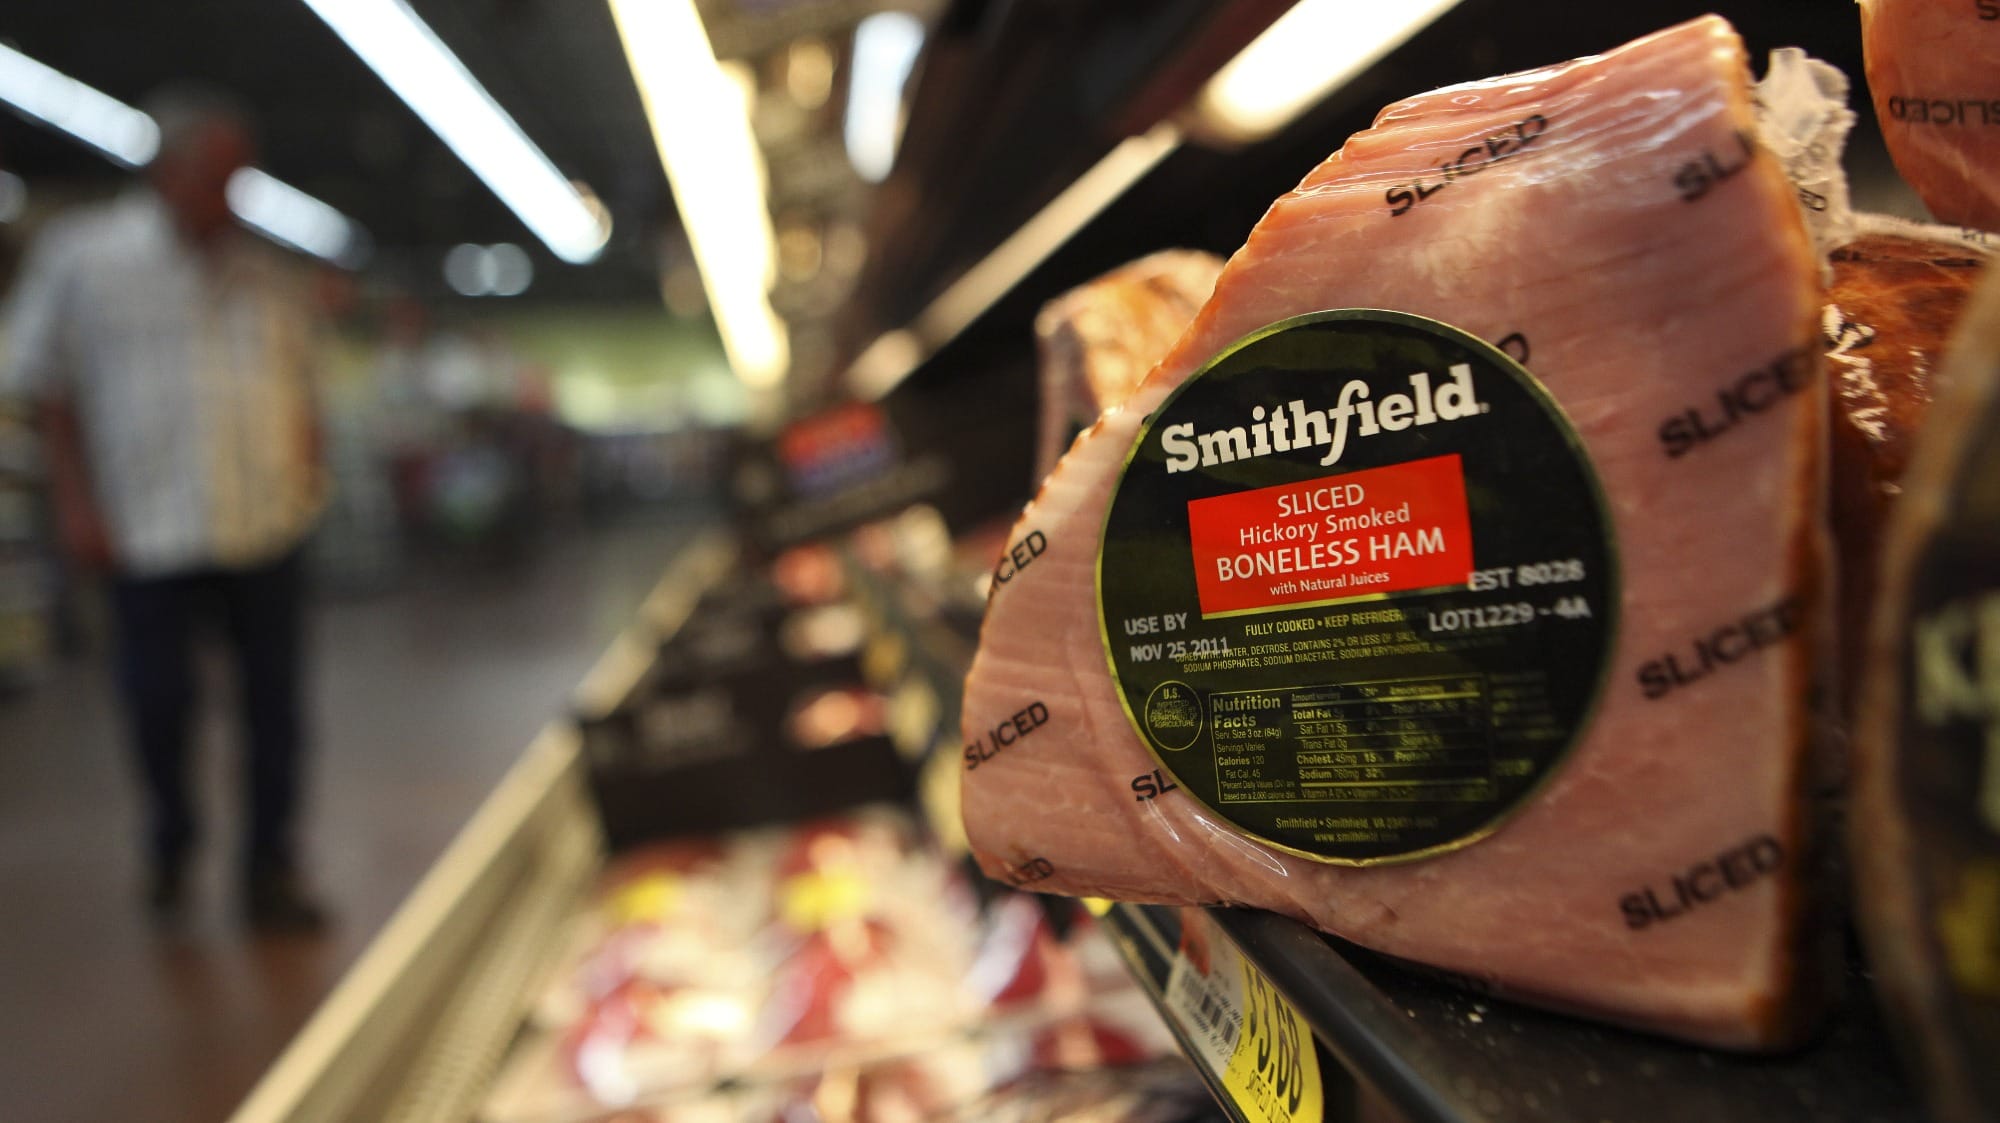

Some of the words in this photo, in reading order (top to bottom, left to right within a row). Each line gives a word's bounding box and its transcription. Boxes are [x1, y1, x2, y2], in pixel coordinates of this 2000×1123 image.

[1386, 114, 1548, 217] SLICED
[1161, 364, 1482, 474] Smithfield
[1277, 484, 1365, 517] SLICED
[1240, 522, 1318, 546] Hickory
[1326, 502, 1410, 534] Smoked
[1217, 539, 1360, 582] BONELESS
[1369, 527, 1446, 562] HAM
[1270, 583, 1297, 596] with
[1300, 574, 1347, 592] Natural
[1350, 571, 1389, 586] Juices
[1468, 567, 1513, 591] EST
[1124, 615, 1160, 636] USE
[1164, 612, 1188, 631] BY
[1245, 622, 1273, 637] FULLY
[1276, 618, 1315, 633] COOKED
[1324, 614, 1350, 628] KEEP
[1352, 608, 1406, 625] REFRIGER
[1429, 602, 1535, 632] LOT1229
[1130, 643, 1163, 662] NOV
[1167, 641, 1187, 658] 25
[1190, 636, 1230, 656] 2011
[1222, 647, 1250, 658] WATER,
[1251, 643, 1291, 656] DEXTROSE,
[1293, 639, 1332, 652] CONTAINS
[1347, 636, 1359, 646] OR
[1360, 633, 1380, 645] LESS
[1183, 661, 1211, 673] SODIUM
[1213, 657, 1262, 671] PHOSPHATES,
[1263, 654, 1293, 666] SODIUM
[1340, 647, 1370, 660] SODIUM
[1163, 687, 1181, 700] U.S.
[1213, 695, 1281, 712] Nutrition
[1214, 713, 1256, 728] Facts
[1292, 709, 1315, 720] Total
[964, 701, 1049, 771] SLICED
[1232, 728, 1246, 738] Size
[1247, 728, 1252, 737] 3
[1253, 729, 1263, 737] oz.
[1316, 723, 1329, 734] Fat
[1216, 743, 1244, 754] Servings
[1245, 742, 1266, 752] Varies
[1303, 739, 1322, 750] Trans
[1218, 756, 1250, 766] Calories
[1296, 754, 1335, 765] Cholest.
[1226, 770, 1237, 779] Fat
[1252, 769, 1261, 778] 45
[1299, 768, 1332, 779] Sodium
[1275, 817, 1318, 829] Smithfield
[1620, 833, 1784, 930] SLICED
